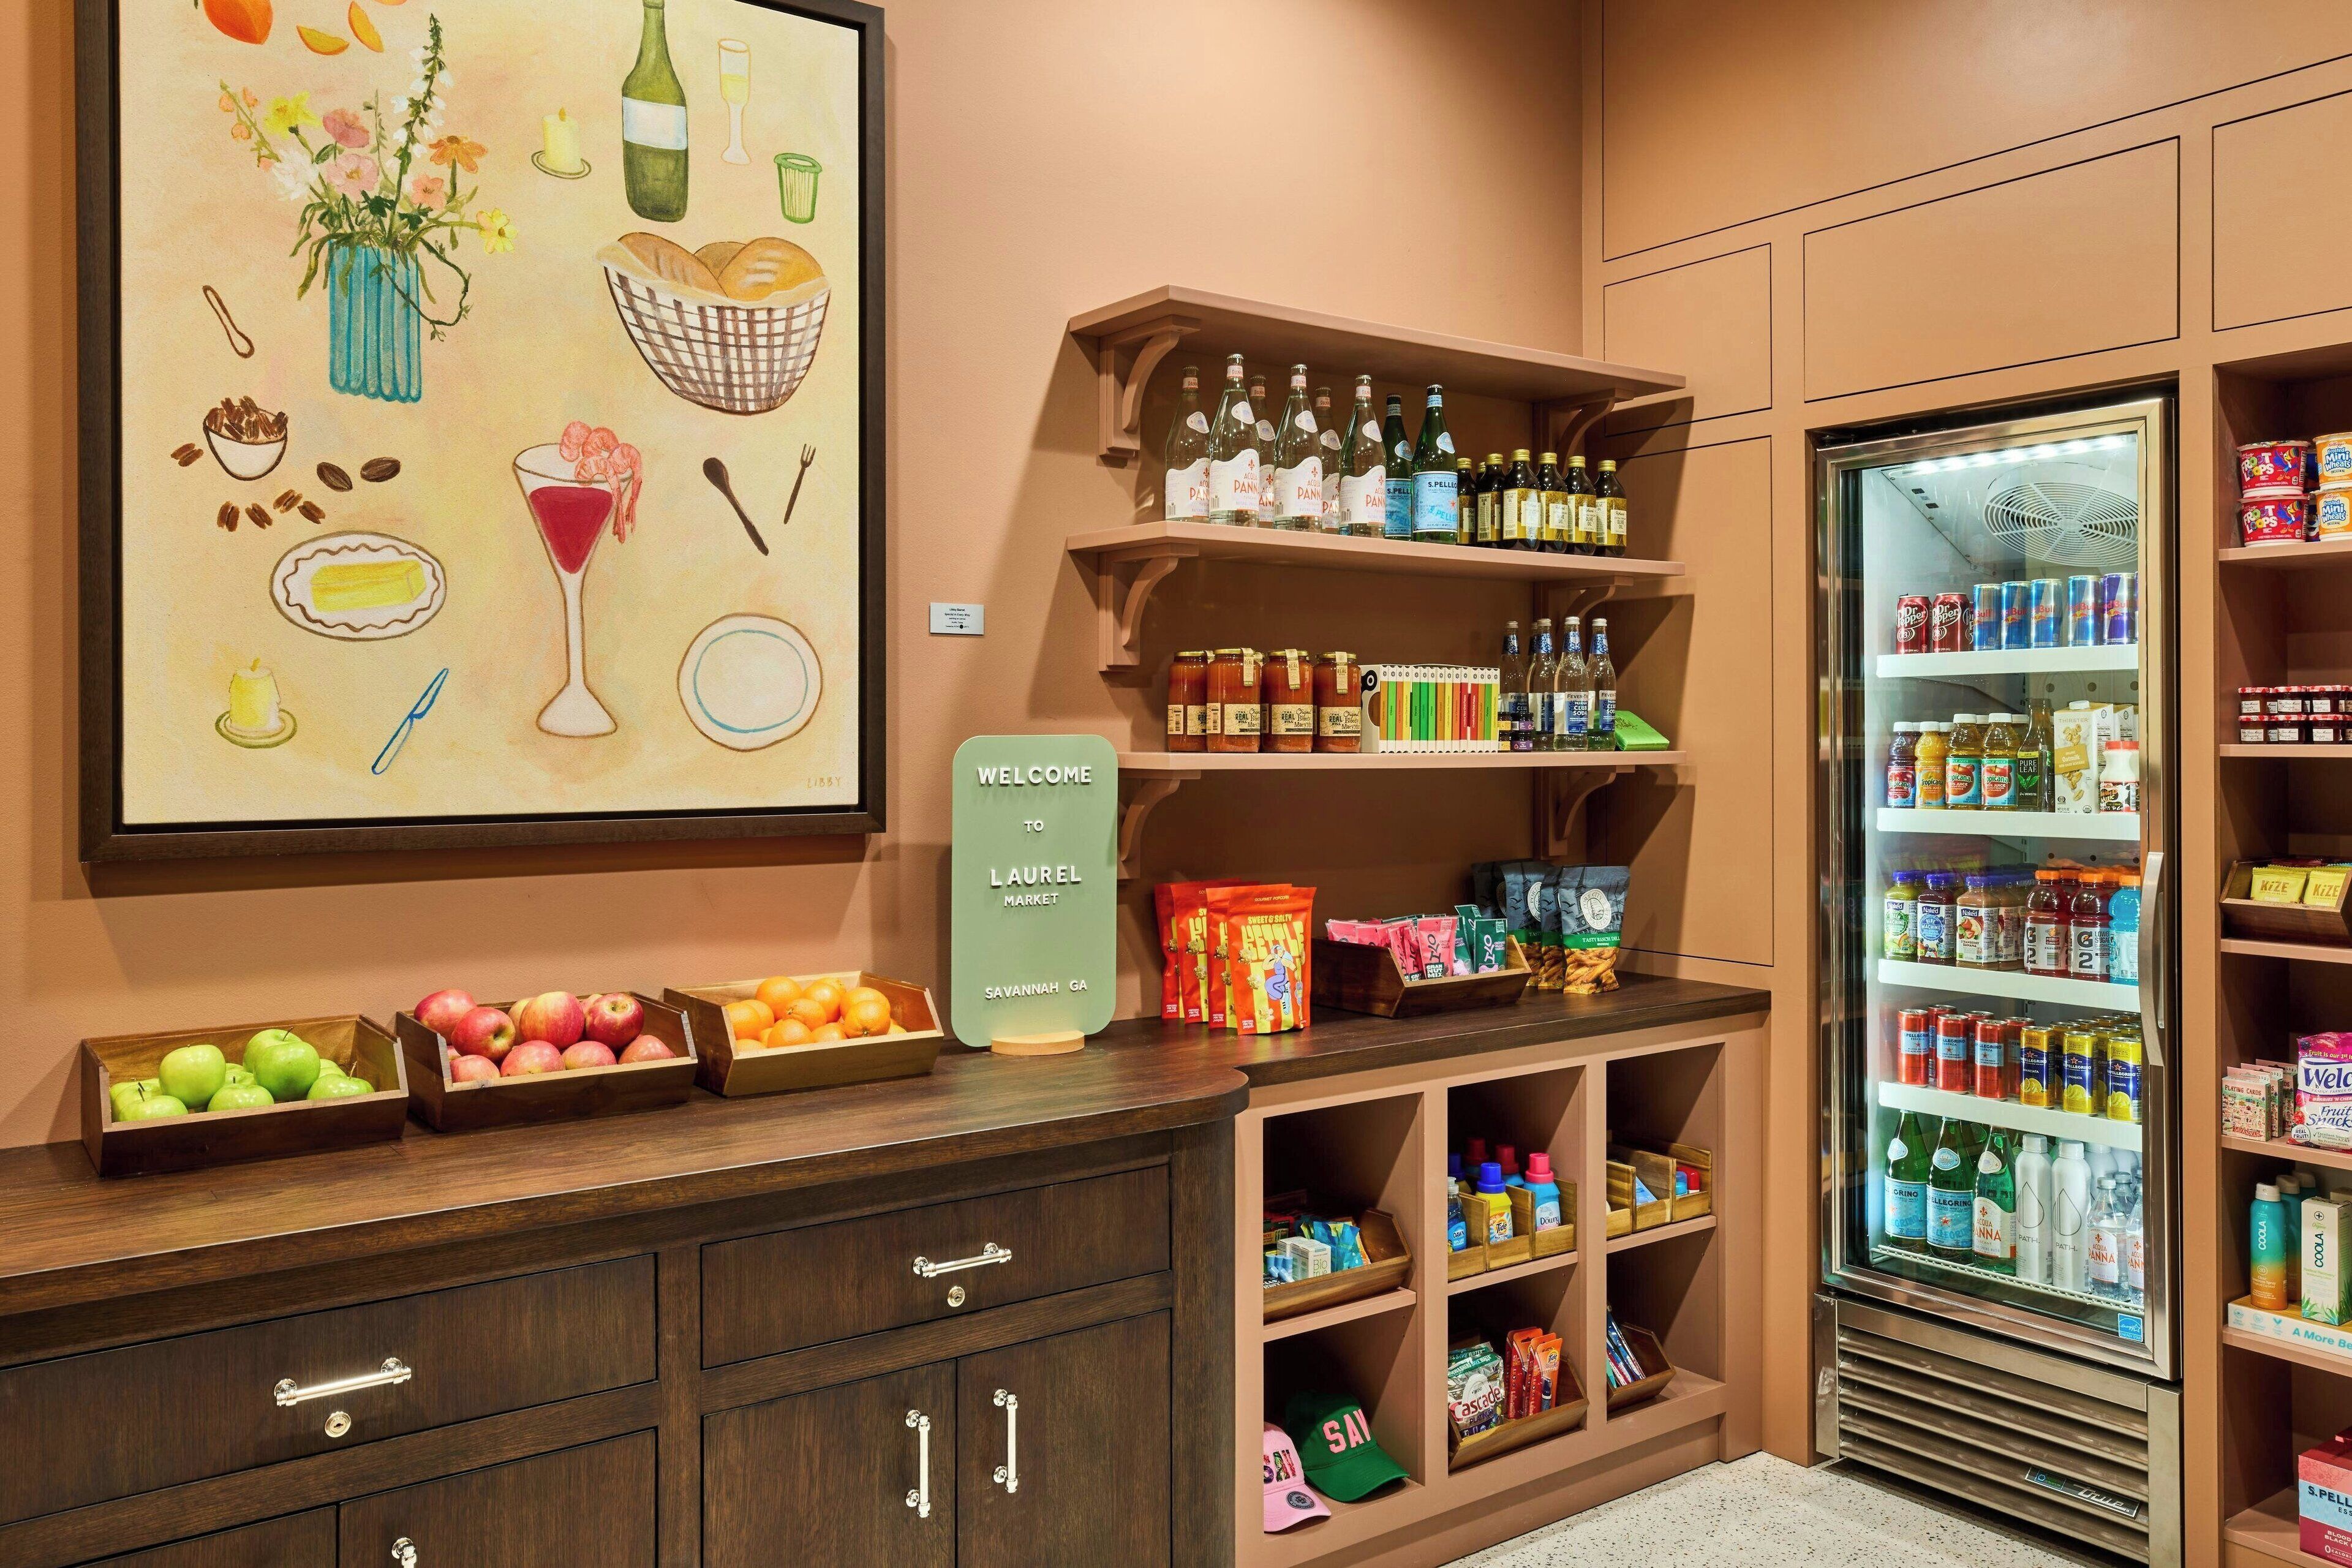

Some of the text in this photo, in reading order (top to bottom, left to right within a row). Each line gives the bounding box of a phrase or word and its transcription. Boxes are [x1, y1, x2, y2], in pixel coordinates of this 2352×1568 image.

[2326, 452, 2350, 462] Mini
[2244, 463, 2275, 482] LOOPS
[2324, 460, 2351, 472] Wheats
[1234, 480, 1259, 494] PANN
[1298, 487, 1322, 500] PANN
[2322, 504, 2345, 513] Mini
[2321, 513, 2345, 523] Wheats
[978, 766, 1091, 785] WELCOME
[807, 777, 840, 790] LIBBY
[1024, 820, 1044, 832] TO
[990, 865, 1081, 886] LAUREL
[2260, 880, 2290, 893] KiZE
[2313, 884, 2340, 897] KiZE
[1005, 893, 1058, 907] MARKET
[1248, 916, 1268, 924] SWEET
[1241, 921, 1304, 961] KETTLE
[2077, 931, 2093, 948] G
[2079, 952, 2093, 969] 2
[985, 980, 1087, 999] SAVANNAH GA
[2303, 1067, 2352, 1089] Welc
[2225, 1085, 2244, 1094] PLAYING
[2321, 1106, 2352, 1116] Fruit
[1540, 1216, 1560, 1225] Downy
[1496, 1223, 1507, 1234] Tide
[2093, 1243, 2108, 1251] ACQUA
[2314, 1233, 2324, 1268] COOLA
[1314, 1259, 1327, 1270] Bio
[2292, 1327, 2352, 1350] A More Be
[1449, 1384, 1502, 1421] Cascade
[1322, 1409, 1371, 1453] SAV
[2308, 1485, 2352, 1508] S.PELL
[2339, 1507, 2352, 1516] ESS
[2324, 1534, 2348, 1547] BLACK
[2328, 1531, 2352, 1542] BLOOD
[2331, 1549, 2352, 1561] CALORI
